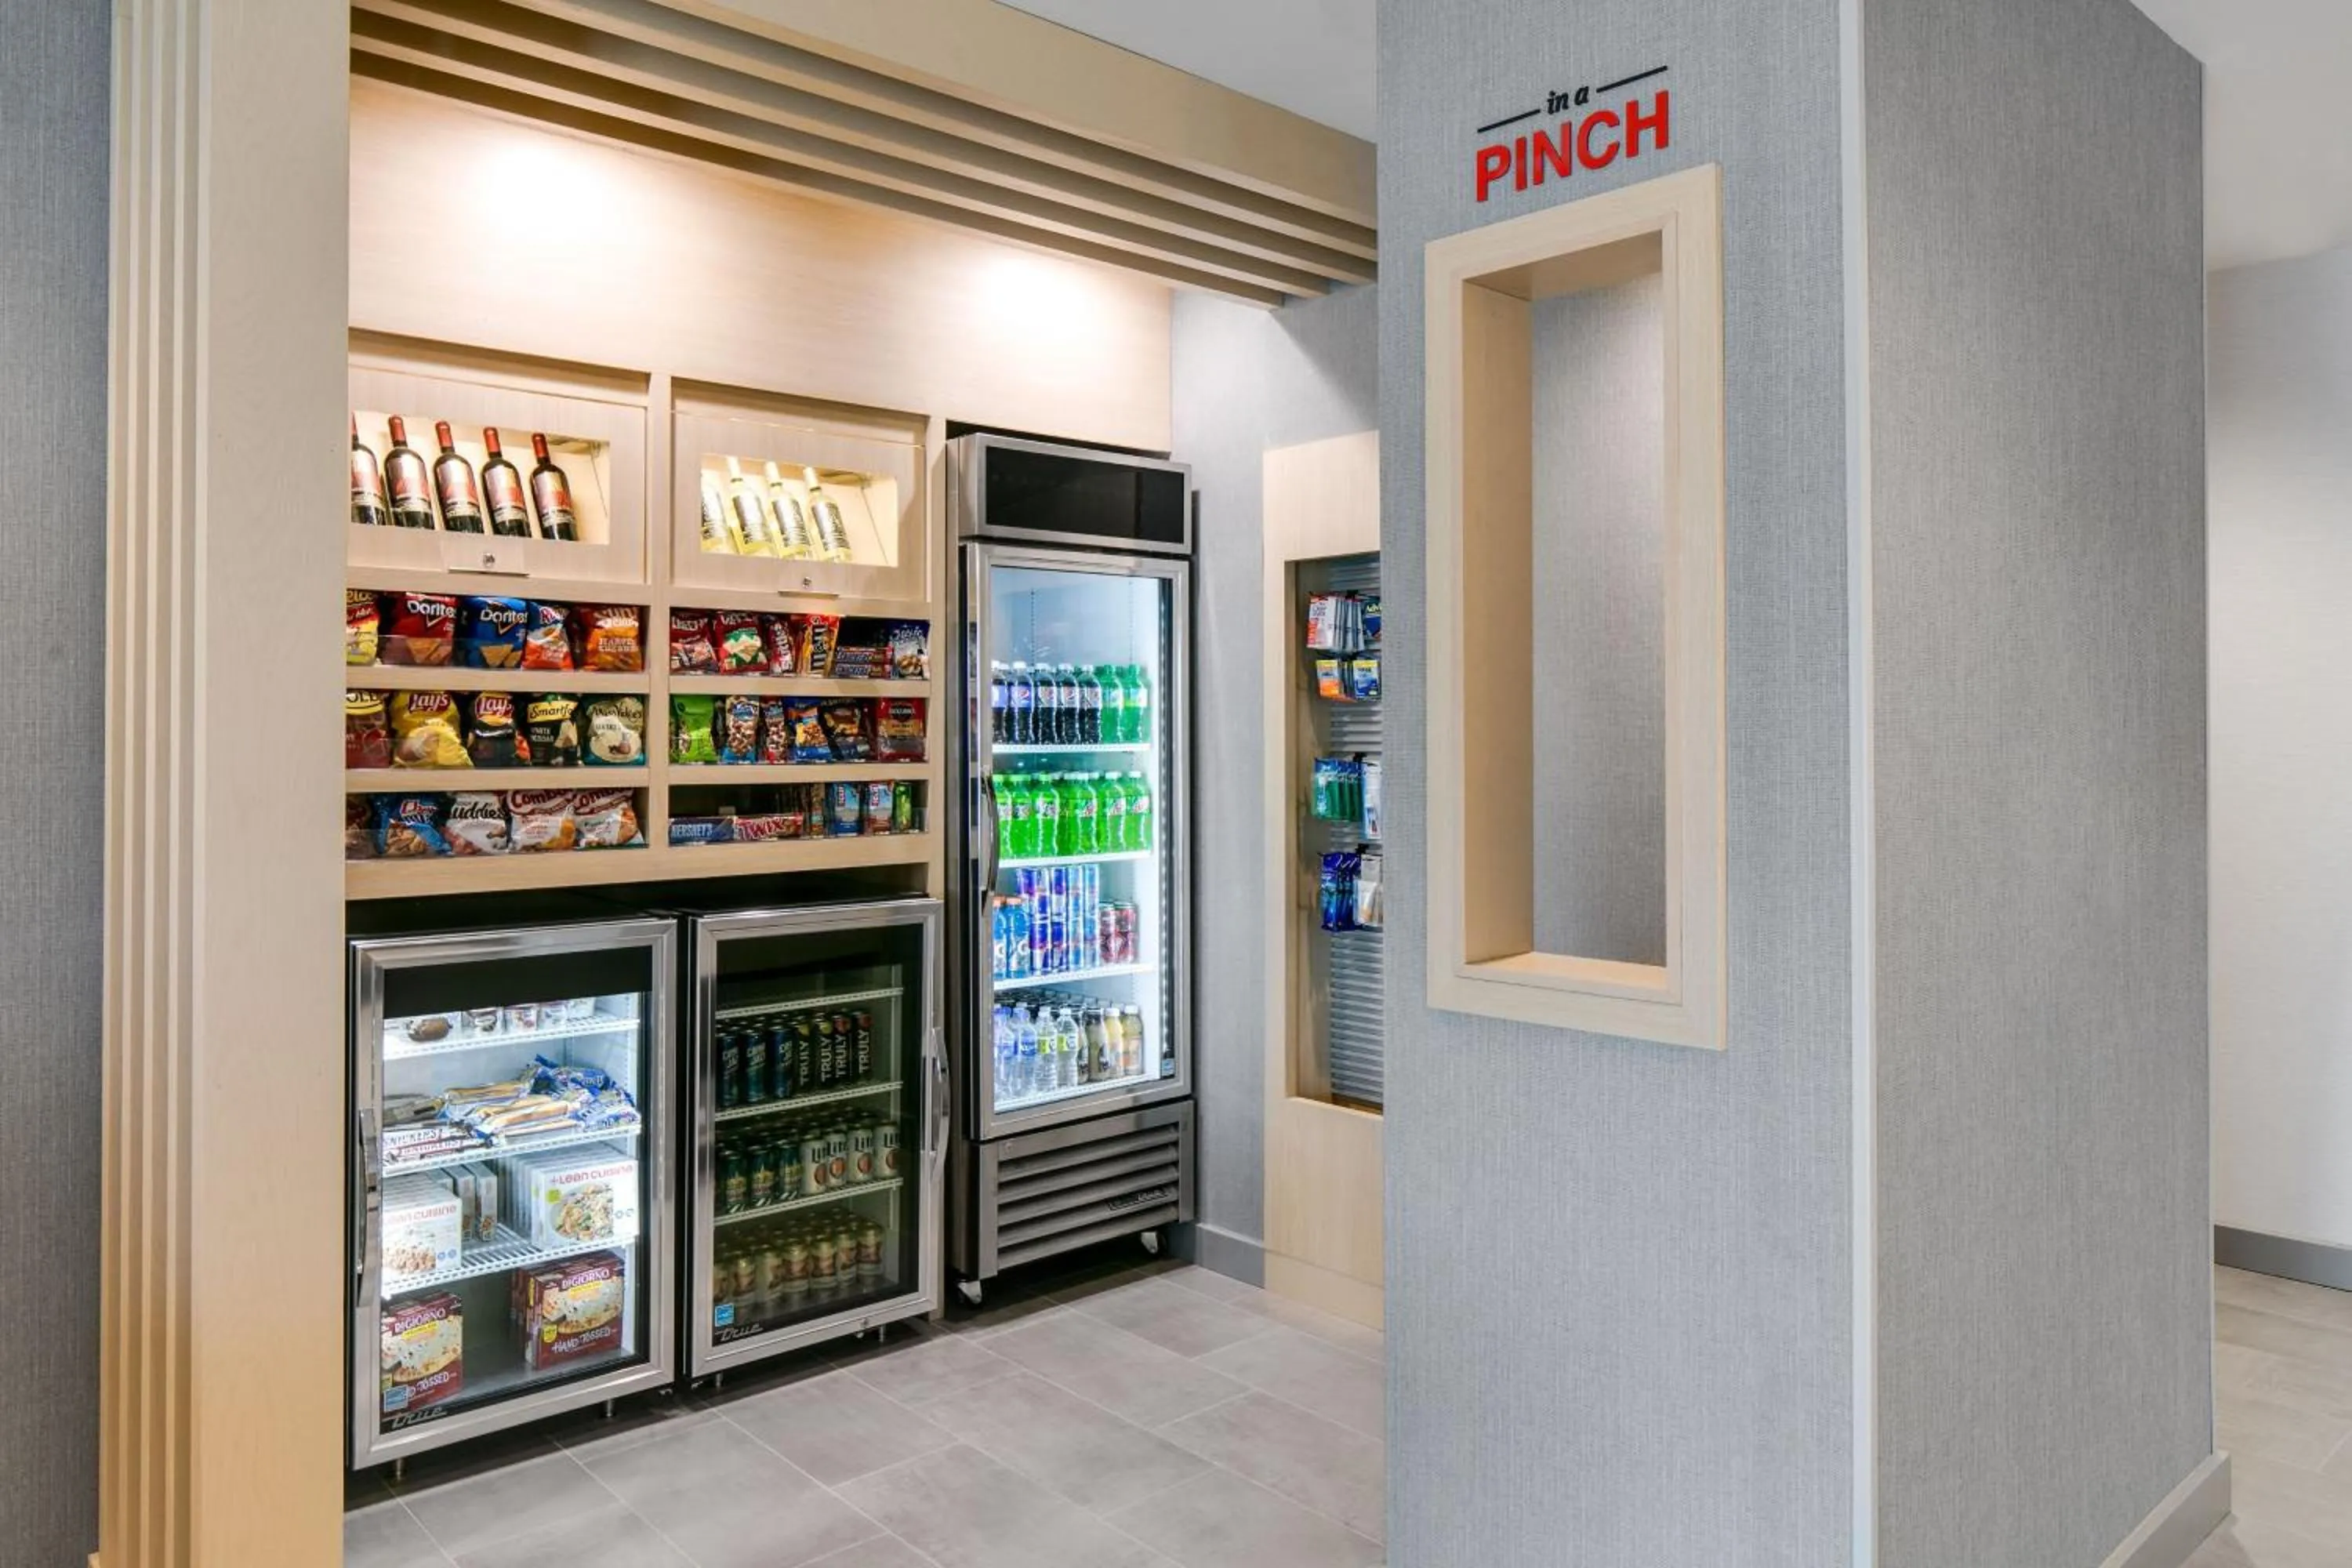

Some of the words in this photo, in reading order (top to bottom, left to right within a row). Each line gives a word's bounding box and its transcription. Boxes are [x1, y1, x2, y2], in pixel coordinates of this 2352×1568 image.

[1547, 90, 1569, 114] in
[1574, 85, 1590, 106] a
[1475, 89, 1669, 202] PINCH
[530, 703, 572, 719] Smartfo
[820, 1036, 832, 1082] TRULY
[835, 1034, 847, 1078] TRULY
[858, 1029, 869, 1073] TRULY
[561, 1268, 610, 1289] DIGIORNO
